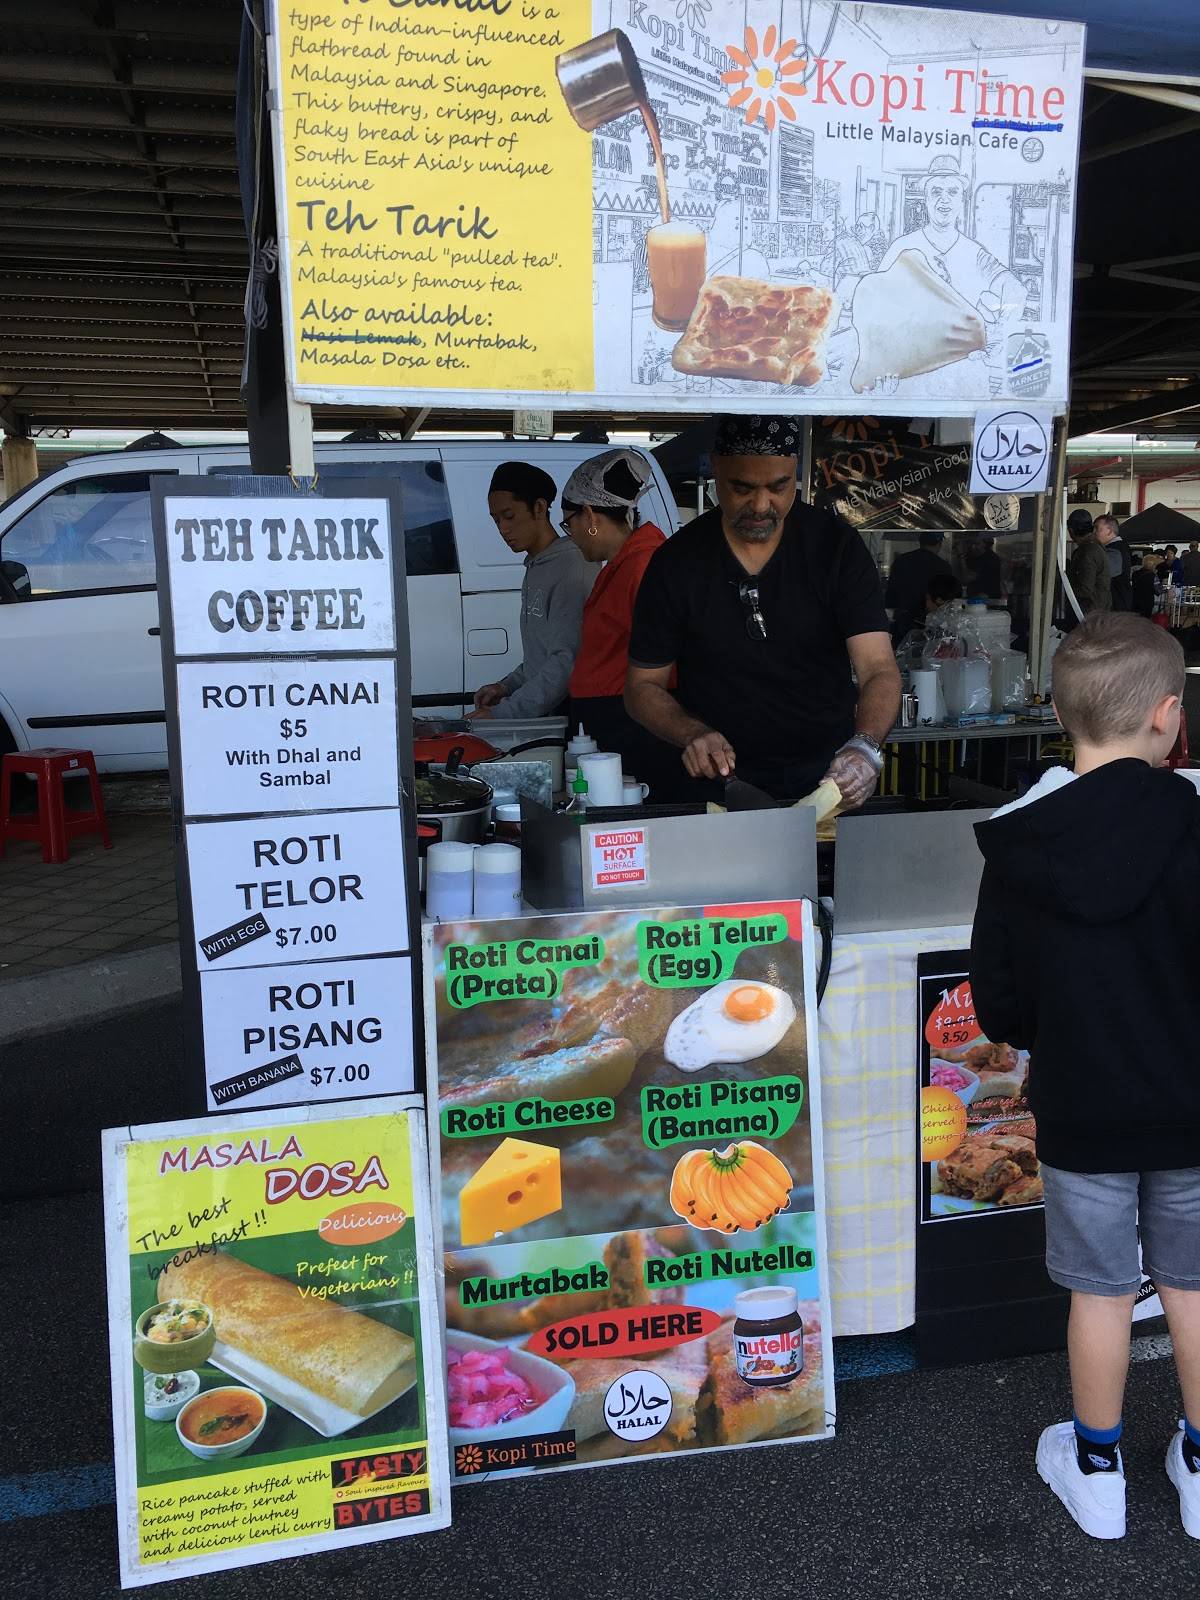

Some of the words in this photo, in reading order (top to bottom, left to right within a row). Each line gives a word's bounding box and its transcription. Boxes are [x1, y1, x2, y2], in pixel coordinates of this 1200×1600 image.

[522, 1, 541, 20] is
[545, 7, 560, 19] a
[627, 0, 686, 51] Kopi
[289, 8, 335, 28] type
[341, 12, 364, 35] of
[369, 15, 565, 46] Indian-influenced
[289, 37, 390, 58] flatbread
[396, 45, 461, 66] found
[466, 48, 491, 67] in
[291, 63, 391, 89] Malaysia
[395, 74, 438, 90] and
[443, 75, 547, 99] Singapore.
[811, 56, 926, 123] Kopi
[945, 69, 1065, 120] Time
[292, 92, 342, 112] This
[348, 95, 429, 119] buttery,
[436, 103, 503, 124] crispy,
[510, 107, 553, 124] and
[294, 119, 349, 141] flaky
[358, 124, 418, 141] bread
[425, 126, 444, 145] is
[449, 128, 494, 149] part
[497, 132, 519, 152] of
[826, 121, 873, 140] Little
[881, 125, 972, 148] Malaysian
[979, 131, 1018, 150] Cafe
[295, 145, 359, 163] South
[364, 150, 409, 168] East
[414, 153, 474, 172] Asia's
[479, 157, 553, 178] unique
[295, 173, 375, 191] cuisine
[297, 199, 378, 234] Teh
[386, 204, 498, 240] Tarik
[297, 241, 313, 257] A
[320, 241, 437, 262] traditional
[443, 247, 518, 269] "pulled
[298, 266, 408, 289] Malaysia's
[411, 272, 486, 292] famous
[490, 271, 522, 292] tea.
[300, 299, 358, 322] Also
[365, 302, 492, 326] available:
[301, 348, 375, 365] Masala
[382, 351, 431, 368] Dosa
[434, 332, 537, 352] Murtabak,
[980, 424, 1043, 461] حلال
[819, 430, 904, 489] Kopi
[863, 465, 932, 500] Malaysian
[933, 446, 969, 473] Food
[988, 464, 1033, 476] HALAL
[928, 487, 952, 504] the
[175, 518, 254, 562] TEH
[262, 518, 384, 561] TARIK
[208, 588, 365, 633] COFFEE
[202, 685, 275, 708] ROTI
[285, 682, 379, 706] CANAI
[280, 718, 307, 739] $5
[226, 750, 270, 765] With
[277, 748, 319, 764] Dhal
[327, 747, 361, 761] and
[260, 770, 331, 787] Sambal
[253, 834, 341, 867] ROTI
[599, 833, 638, 845] CAUTION
[603, 847, 636, 861] HOT
[604, 861, 637, 870] SURFACE
[236, 875, 364, 910] TELOR
[203, 933, 237, 955] WITH
[237, 920, 265, 940] EGG
[275, 924, 337, 948] $7.00
[646, 925, 701, 951] Roti
[708, 921, 778, 945] Telur
[449, 943, 507, 970] Roti
[516, 937, 599, 965] Canai
[647, 951, 723, 984] (Egg)
[269, 980, 355, 1012] ROTI
[450, 968, 558, 1006] (Prata)
[243, 1017, 382, 1054] PISANG
[942, 1031, 969, 1044] 8.50
[213, 1080, 247, 1100] WITH
[248, 1061, 299, 1087] BANANA
[310, 1063, 370, 1086] $7.00
[646, 1086, 702, 1112] Roti
[711, 1081, 801, 1109] Pisang
[447, 1105, 505, 1134] Roti
[515, 1099, 612, 1127] Cheese
[648, 1107, 779, 1147] (Banana)
[922, 1118, 955, 1129] served
[160, 1135, 303, 1174] MASALA
[265, 1156, 388, 1204] DOSA
[136, 1225, 183, 1251] The
[188, 1196, 232, 1229] best
[318, 1211, 407, 1233] Delicious
[148, 1220, 251, 1280] breakfast
[254, 1209, 267, 1227] !!
[296, 1256, 359, 1278] Prefect
[363, 1252, 388, 1271] for
[647, 1256, 703, 1284] Roti
[711, 1246, 814, 1275] Nutella
[298, 1275, 399, 1299] Vegeterians
[404, 1270, 414, 1284] !!
[463, 1265, 609, 1305] Murtabak
[545, 1321, 620, 1354] SOLD
[627, 1311, 703, 1341] HERE
[738, 1331, 801, 1356] nutella
[608, 1383, 669, 1418] حلال
[617, 1416, 662, 1430] HALAL
[341, 1451, 422, 1481] TASTY
[486, 1443, 528, 1466] Kopi
[531, 1438, 576, 1459] Time
[142, 1497, 175, 1512] Rice
[179, 1486, 240, 1506] pancake
[244, 1475, 292, 1495] stuffed
[296, 1470, 331, 1488] with
[345, 1487, 362, 1497] Soul
[364, 1482, 395, 1494] inspired
[397, 1479, 426, 1490] flavours
[142, 1509, 195, 1528] creamy
[200, 1501, 248, 1522] potato,
[253, 1490, 297, 1509] served
[143, 1528, 179, 1543] with
[182, 1516, 239, 1535] coconut
[241, 1507, 299, 1527] chutney
[336, 1493, 422, 1525] BYTES
[143, 1546, 174, 1559] and
[178, 1533, 244, 1552] delicious
[249, 1524, 289, 1540] lentil
[293, 1517, 332, 1535] curry
